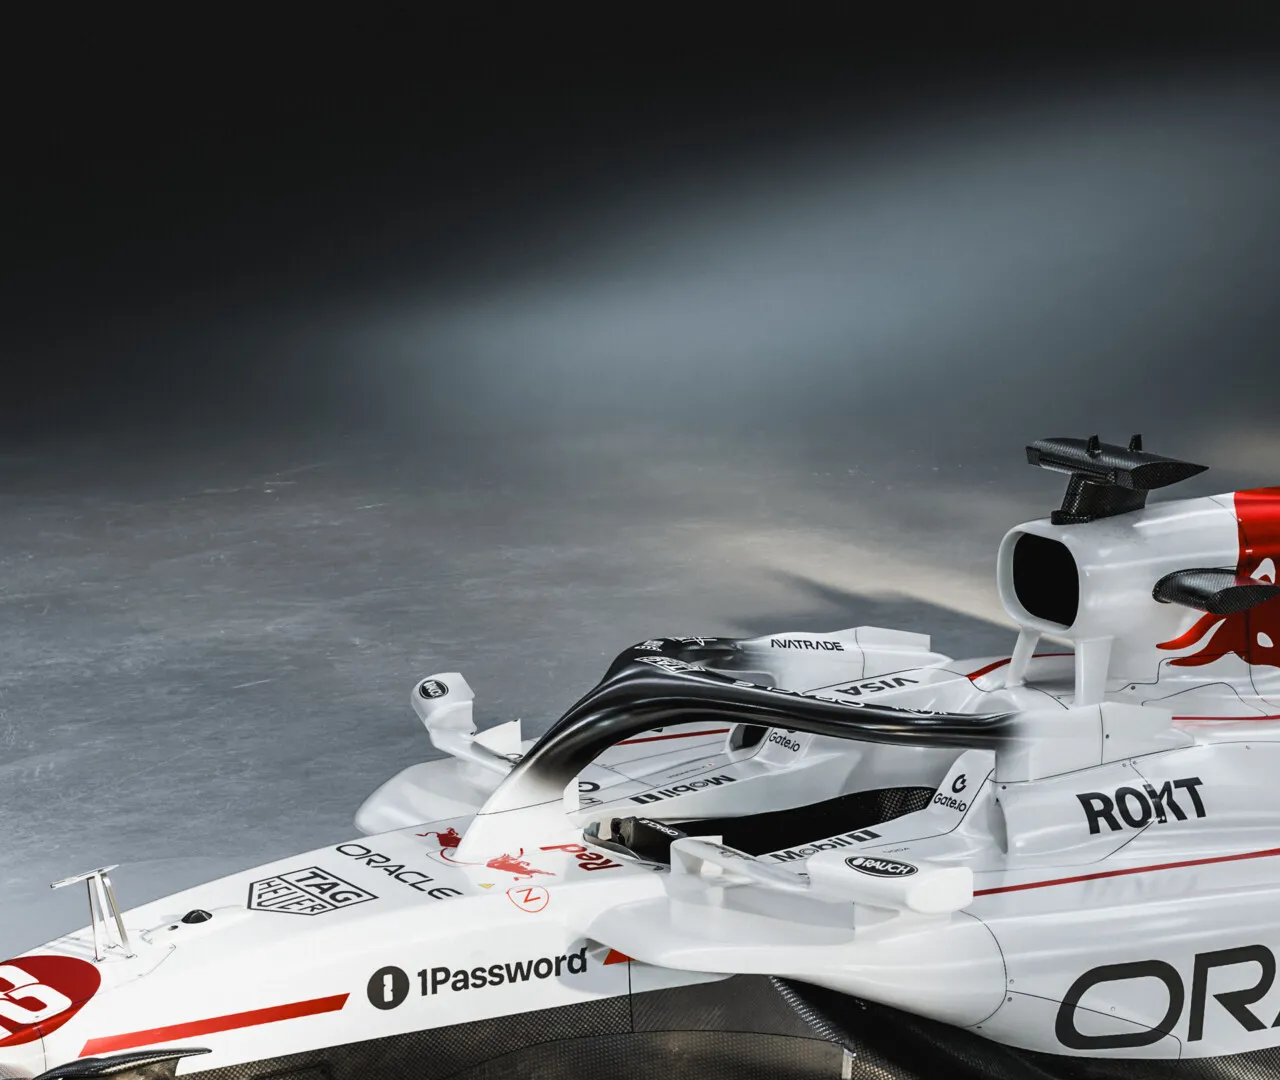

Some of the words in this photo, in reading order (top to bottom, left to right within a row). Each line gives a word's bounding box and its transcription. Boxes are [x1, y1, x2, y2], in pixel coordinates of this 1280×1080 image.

[771, 639, 844, 651] AVATRADE
[835, 677, 920, 696] VISA
[768, 732, 800, 752] Gate.io
[662, 774, 737, 799] Mobil
[933, 792, 967, 812] Gate.io
[1076, 777, 1208, 835] ROKT
[770, 836, 855, 862] Mobil
[334, 843, 464, 900] ORACLE
[862, 857, 910, 875] RAUCH
[256, 876, 326, 915] HEUER
[293, 869, 364, 906] TAG
[417, 946, 588, 996] 1Password
